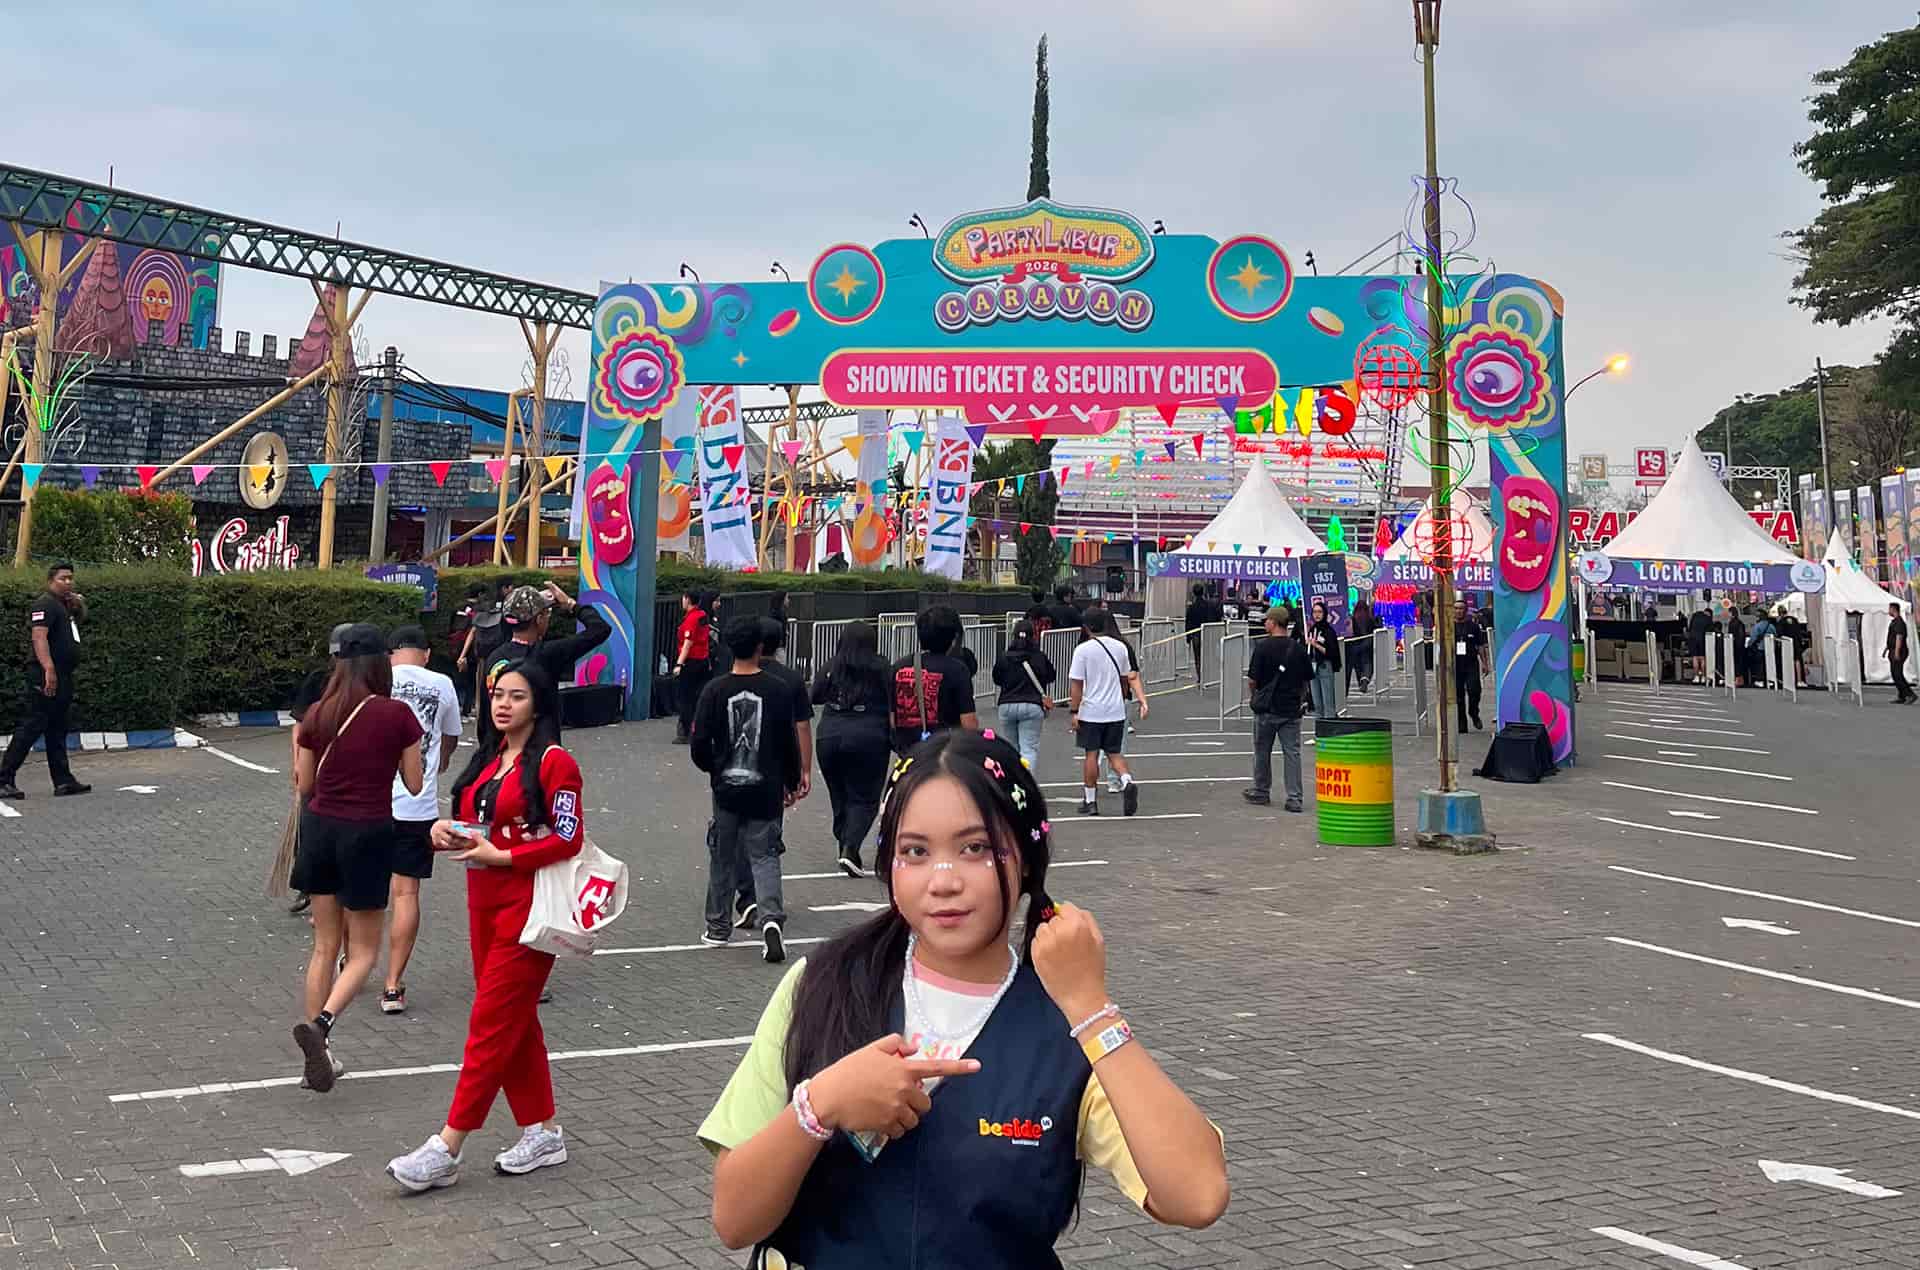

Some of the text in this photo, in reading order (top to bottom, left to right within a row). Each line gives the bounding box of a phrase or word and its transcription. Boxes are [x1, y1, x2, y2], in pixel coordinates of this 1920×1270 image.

[1025, 261, 1058, 272] 2026
[945, 287, 1144, 320] CARAVAN
[847, 364, 1246, 395] SHOWING TICKET & SECURITY CHECK
[931, 479, 967, 554] BNI
[1180, 558, 1289, 576] SECURITY CHECK
[1393, 564, 1495, 581] SECUY CHE
[1639, 563, 1764, 586] LOCKER ROOM
[1313, 572, 1334, 583] FAST
[1312, 583, 1338, 594] TRACK
[557, 793, 572, 811] HS
[558, 816, 574, 833] HS
[979, 1117, 1042, 1138] beside
